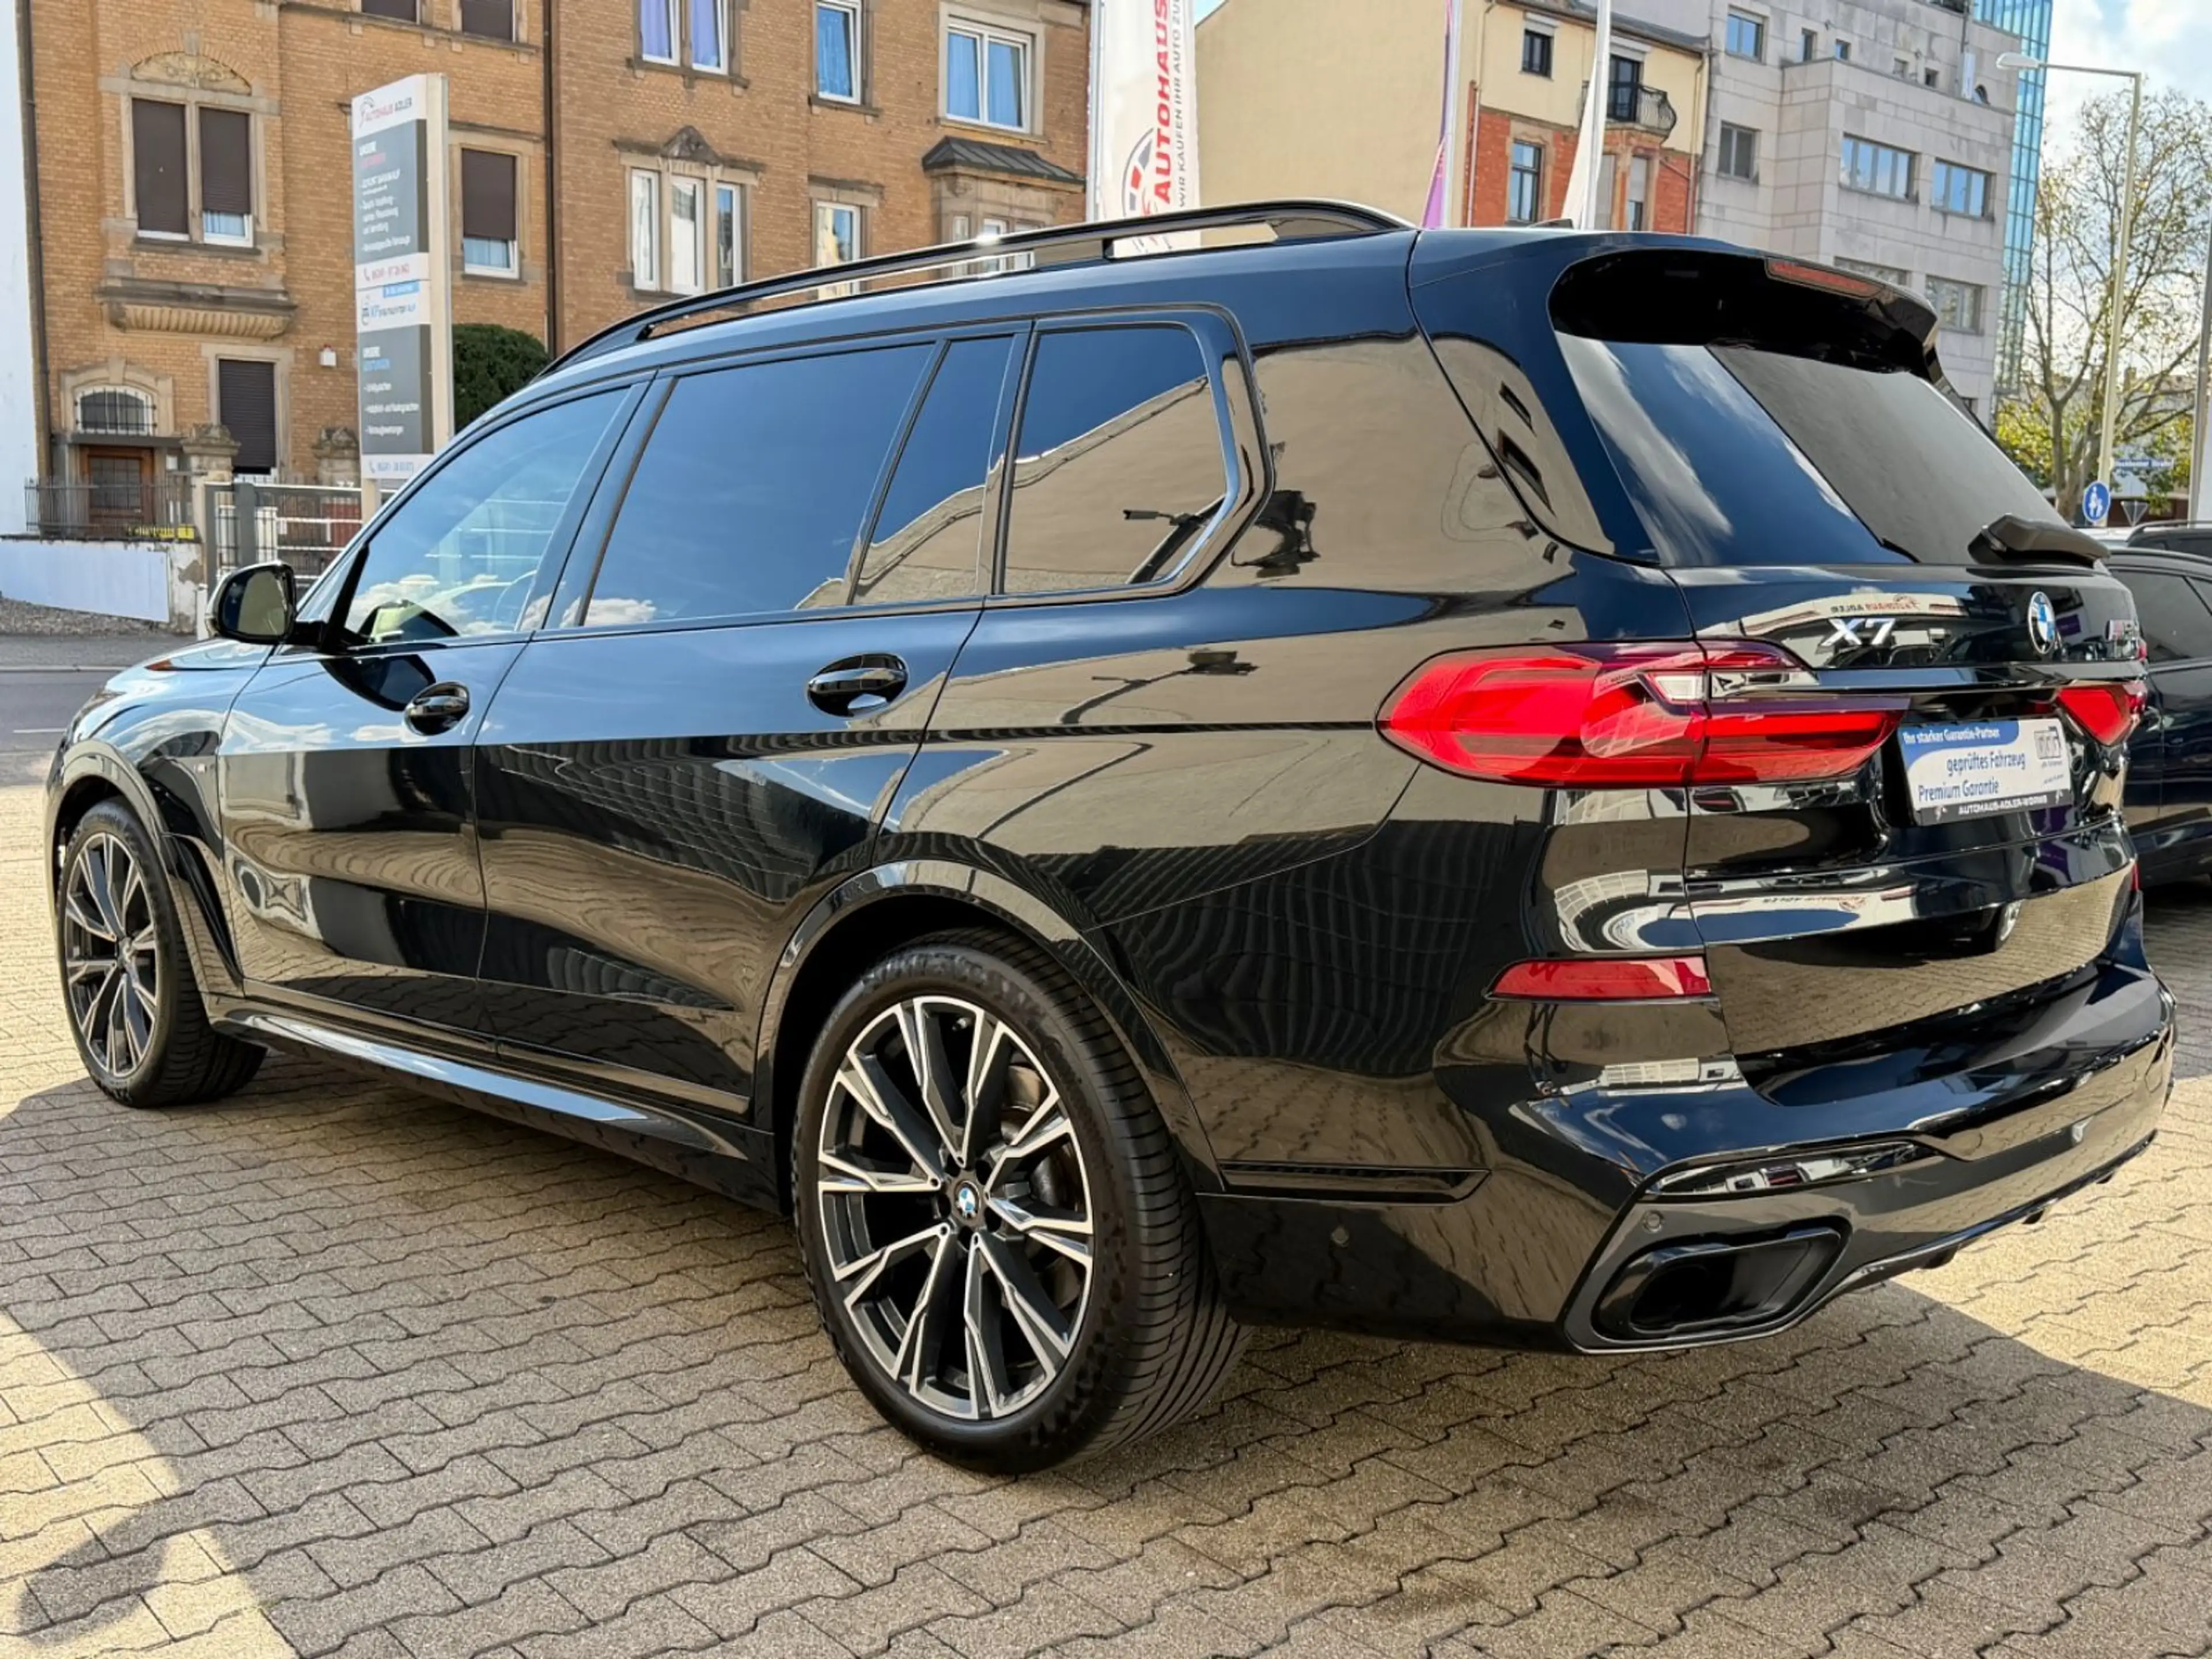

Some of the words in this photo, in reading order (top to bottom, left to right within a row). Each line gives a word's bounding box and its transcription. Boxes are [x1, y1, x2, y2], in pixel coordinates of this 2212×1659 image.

[1172, 0, 1181, 25] ZU
[1172, 29, 1182, 73] AUTO
[1154, 0, 1172, 204] AUTOHAUS
[1173, 77, 1183, 105] IHR
[1173, 109, 1186, 172] KAUFEN
[1177, 177, 1186, 207] WIR
[1821, 618, 1896, 646] X7
[1946, 753, 1988, 777] geprüftes
[1989, 751, 2026, 771] Fahrzeug
[1918, 781, 1960, 802] Premium
[1962, 777, 1999, 797] Garantie
